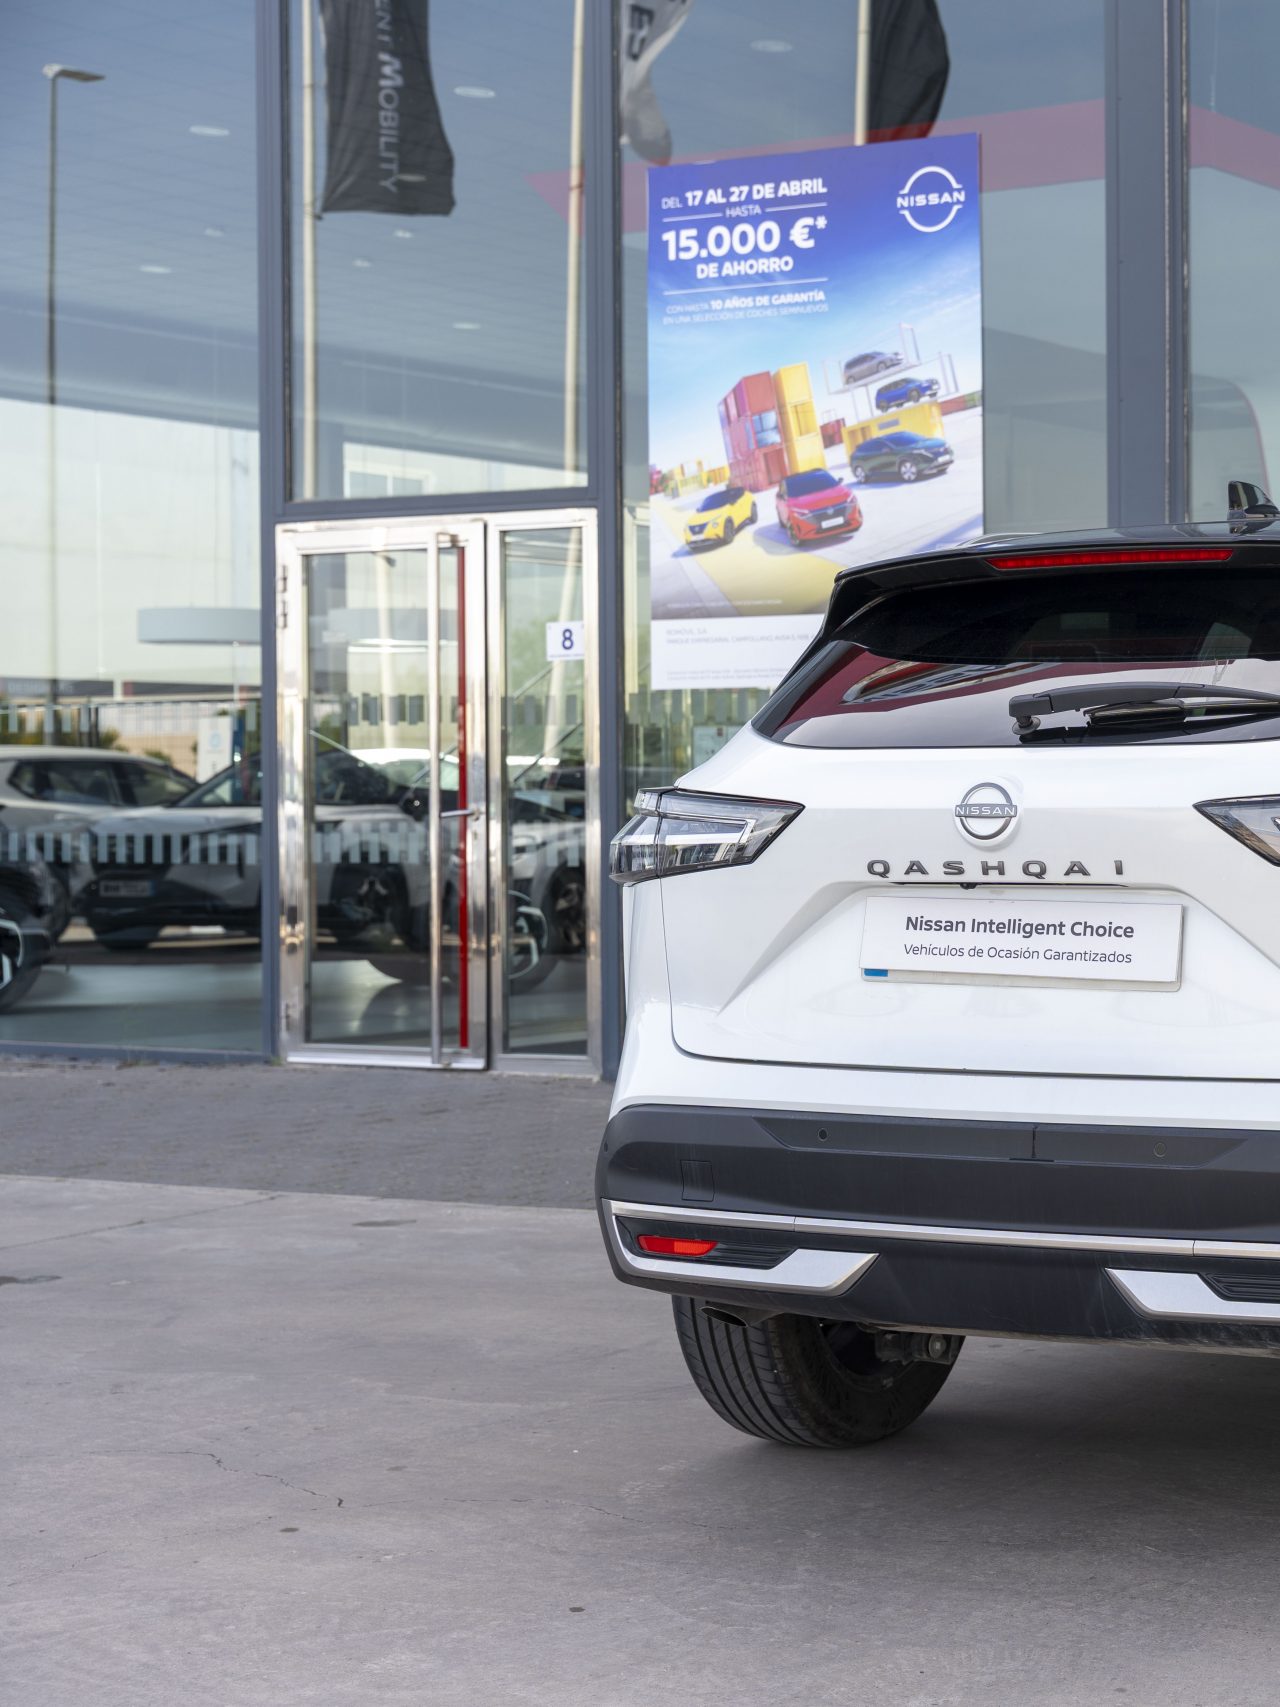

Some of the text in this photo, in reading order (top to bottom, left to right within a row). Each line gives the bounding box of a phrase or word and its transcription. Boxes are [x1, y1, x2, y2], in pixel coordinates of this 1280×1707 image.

[378, 52, 404, 192] MOBILITY
[661, 178, 828, 209] DEL 17 AL 27 DE ABRIL
[896, 190, 966, 208] NISSAN
[725, 204, 762, 218] HASTA
[661, 220, 781, 261] 15.000
[696, 256, 794, 279] DE AHORRO
[710, 299, 723, 310] 10
[724, 295, 754, 309] AÑOS
[756, 296, 769, 306] DE
[562, 628, 575, 651] 8
[956, 806, 1015, 815] NISSAN
[866, 859, 1124, 879] QASHQAI
[905, 915, 1135, 939] Nissan Intelligent Choice
[904, 943, 1132, 964] Vehículos de Ocasión Garantizados
